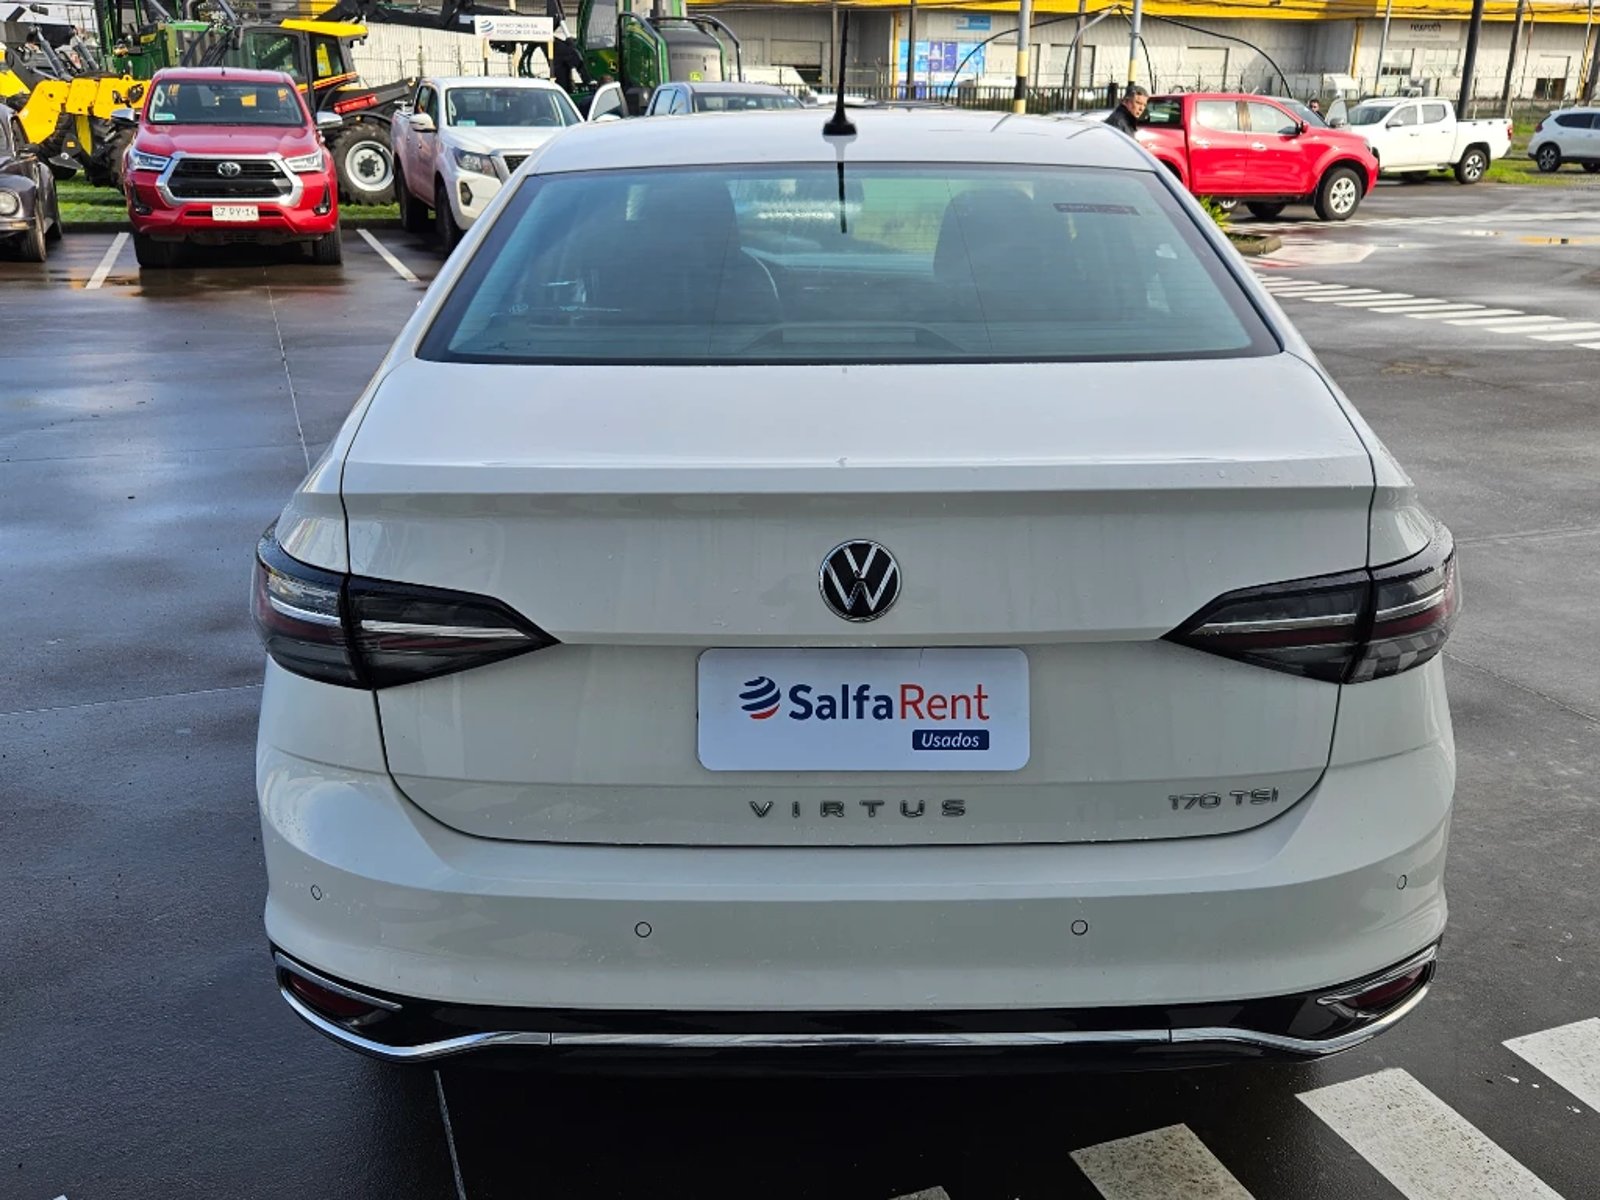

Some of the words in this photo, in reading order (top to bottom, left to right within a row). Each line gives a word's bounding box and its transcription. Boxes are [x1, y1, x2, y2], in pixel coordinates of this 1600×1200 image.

[788, 683, 990, 721] SalfaRent
[921, 732, 979, 748] Usados
[749, 799, 966, 818] VIRTUS
[1168, 791, 1222, 810] 170
[1229, 786, 1279, 806] TSI
